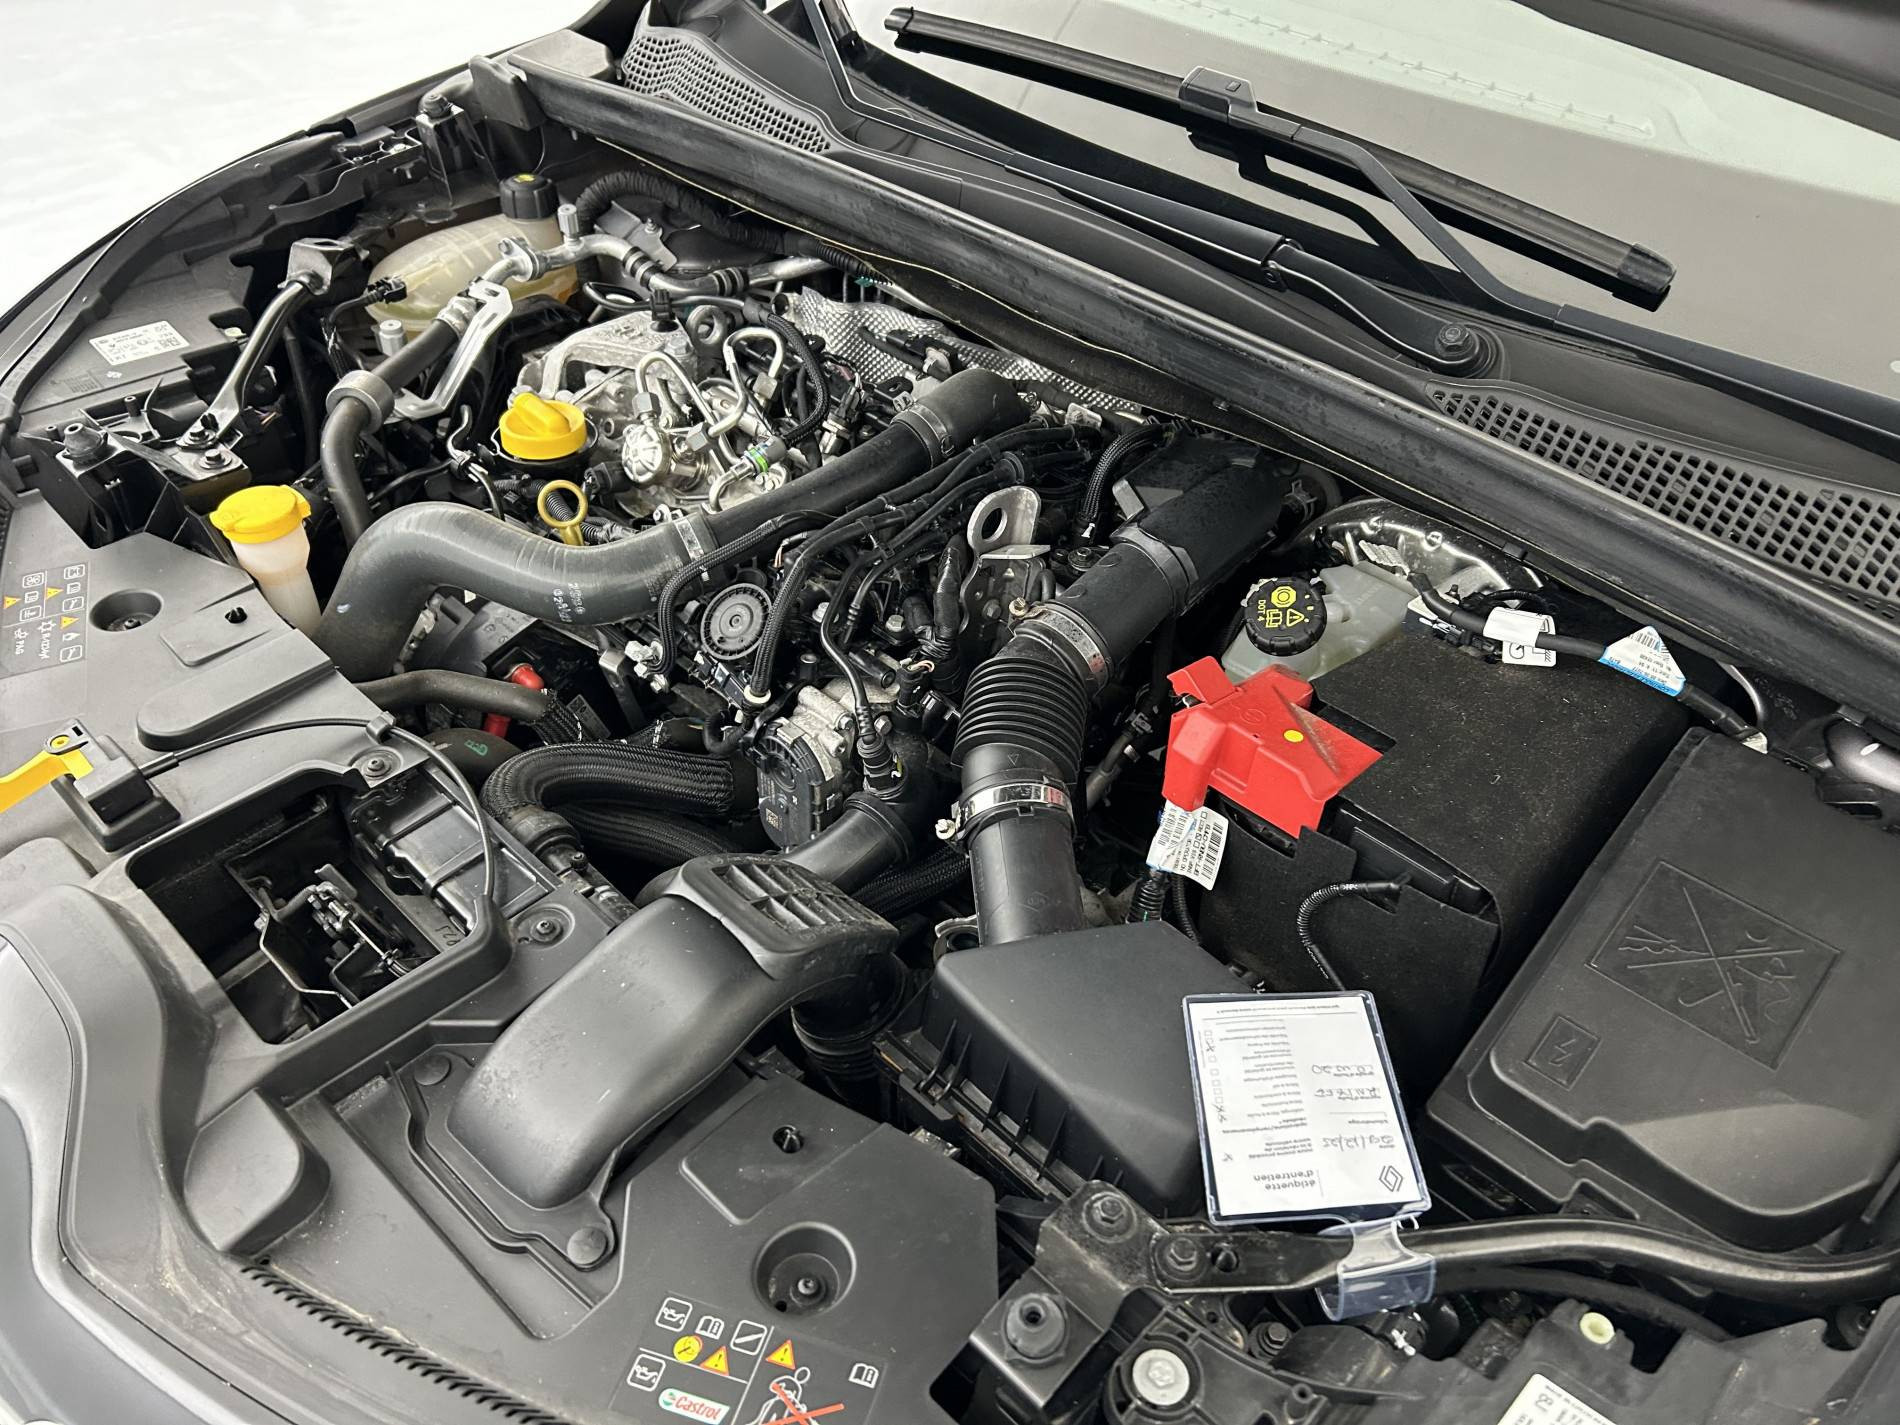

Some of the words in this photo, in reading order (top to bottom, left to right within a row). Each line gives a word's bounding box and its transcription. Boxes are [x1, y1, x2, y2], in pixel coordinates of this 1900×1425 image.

[1258, 600, 1266, 615] DOT
[1254, 1170, 1314, 1181] d'entretien
[1264, 1179, 1316, 1190] étiquette
[675, 1395, 722, 1420] Castrol
